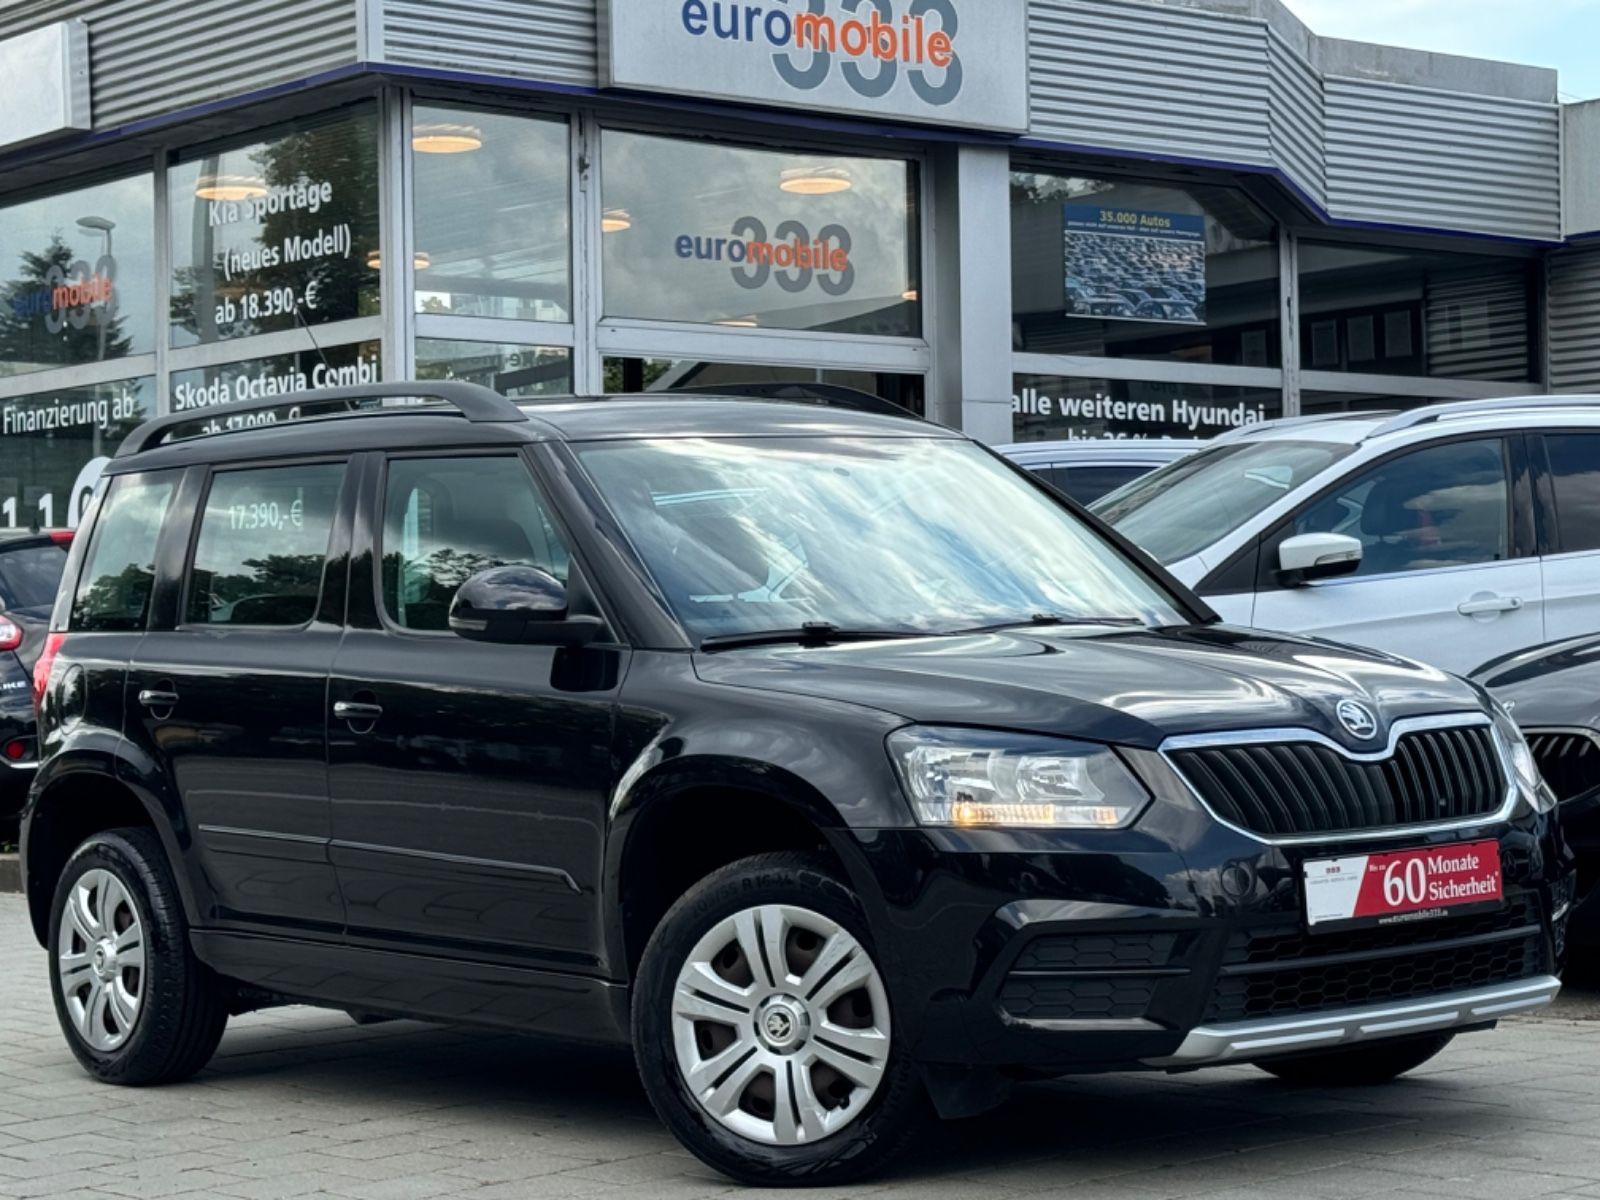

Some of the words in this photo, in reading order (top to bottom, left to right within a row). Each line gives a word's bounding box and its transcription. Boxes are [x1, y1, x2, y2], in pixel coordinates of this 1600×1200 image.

[681, 0, 953, 67] euromobile
[770, 0, 963, 106] 333
[209, 200, 238, 227] Kia
[244, 181, 333, 225] Sportage
[1099, 210, 1137, 225] 35.000
[1140, 213, 1171, 228] Autos
[223, 246, 281, 282] (neues
[283, 223, 351, 264] Modell)
[674, 234, 848, 272] euromobile
[730, 215, 856, 296] 333
[214, 296, 236, 325] ab
[174, 377, 230, 411] Skoda
[235, 366, 307, 402] Octavia
[311, 354, 378, 390] Combi
[3, 398, 108, 435] Finanzierung
[112, 387, 134, 420] ab
[1011, 388, 1051, 415] alle
[1058, 393, 1165, 423] weiteren
[1171, 399, 1265, 431] Hyundai
[1383, 857, 1427, 907] 60
[1427, 853, 1480, 876] Monate
